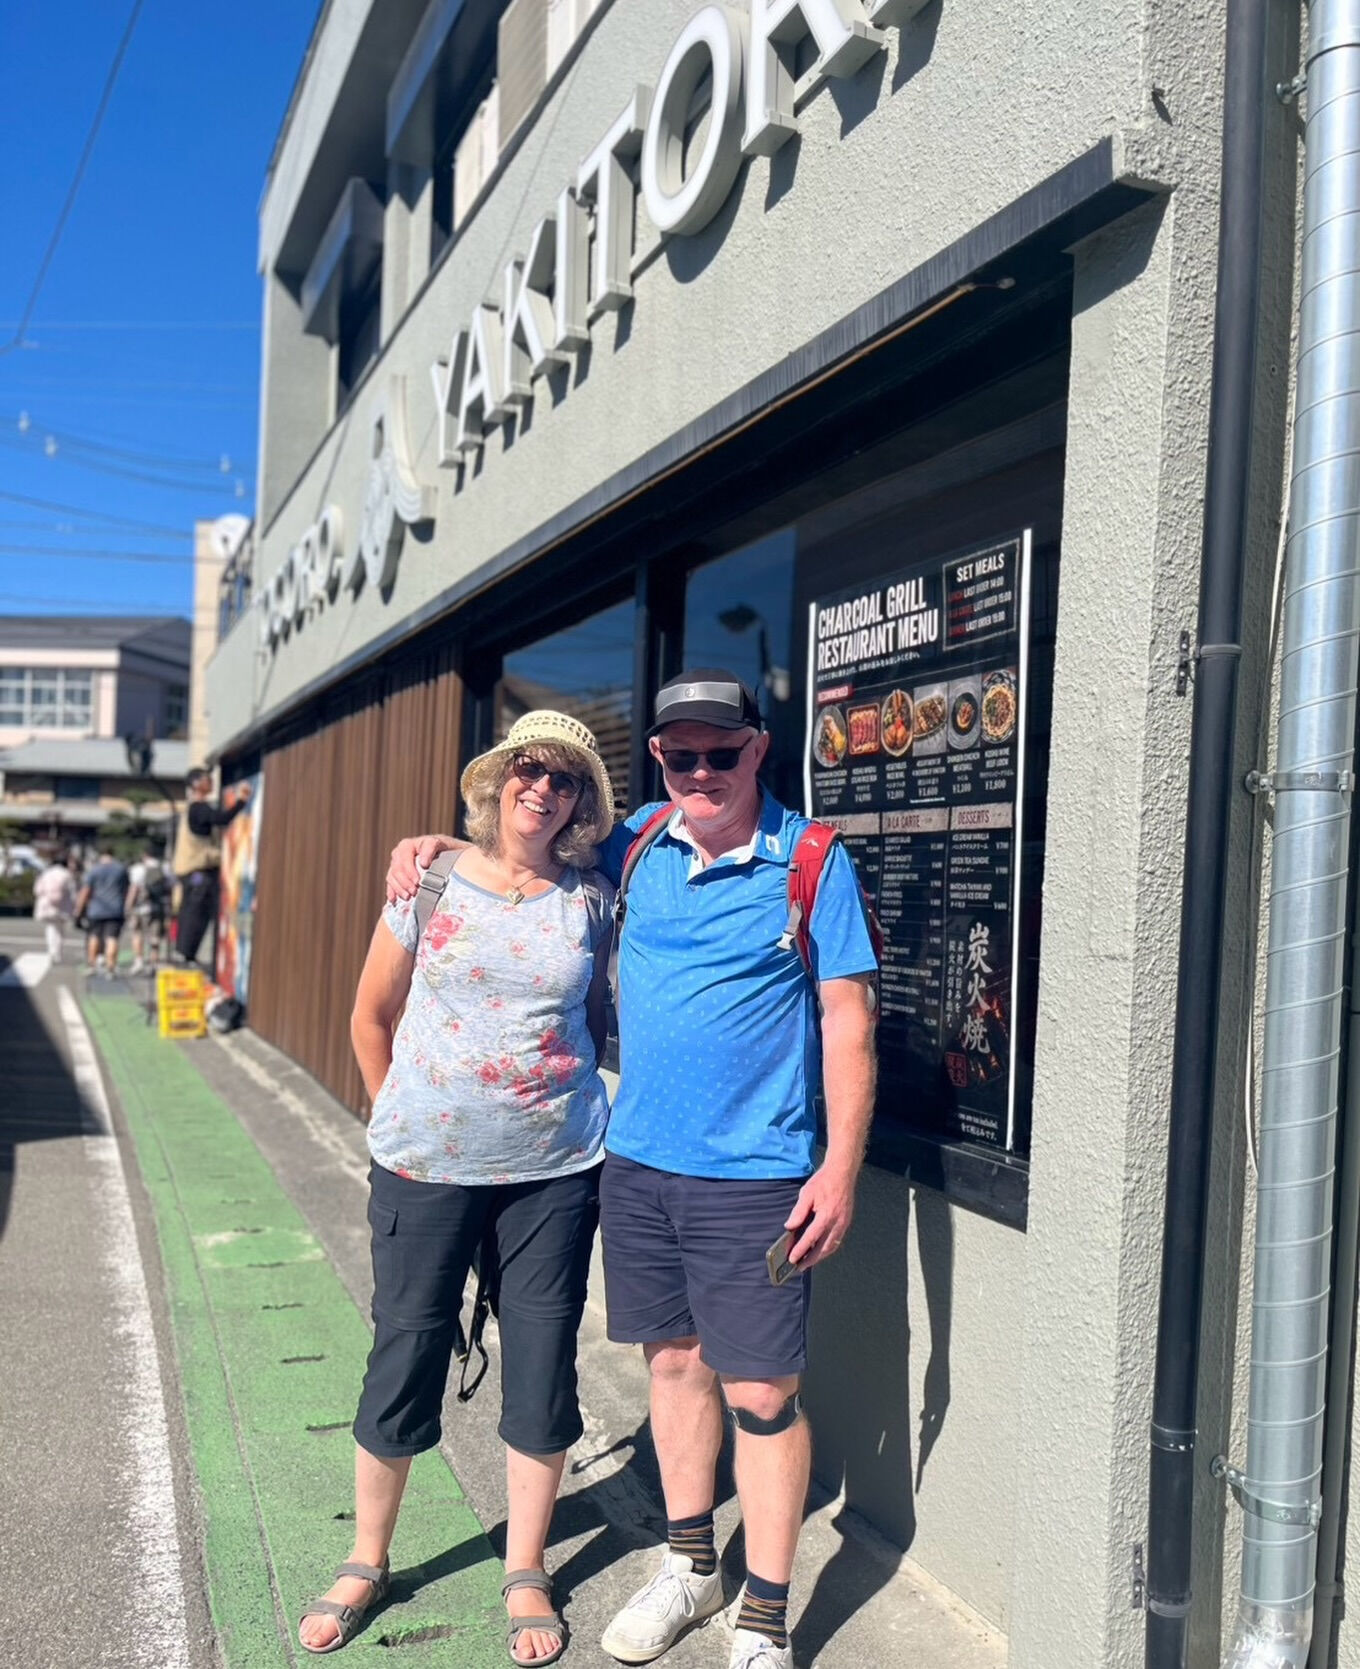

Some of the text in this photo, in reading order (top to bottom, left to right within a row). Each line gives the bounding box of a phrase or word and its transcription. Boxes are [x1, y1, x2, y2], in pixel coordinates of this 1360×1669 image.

[430, 0, 943, 468] YAKITOR
[956, 552, 1005, 583] SET MEALS
[817, 576, 927, 640] CHARCOAL GRILL
[817, 621, 896, 671] RESTAURANT
[898, 608, 938, 650] MENU
